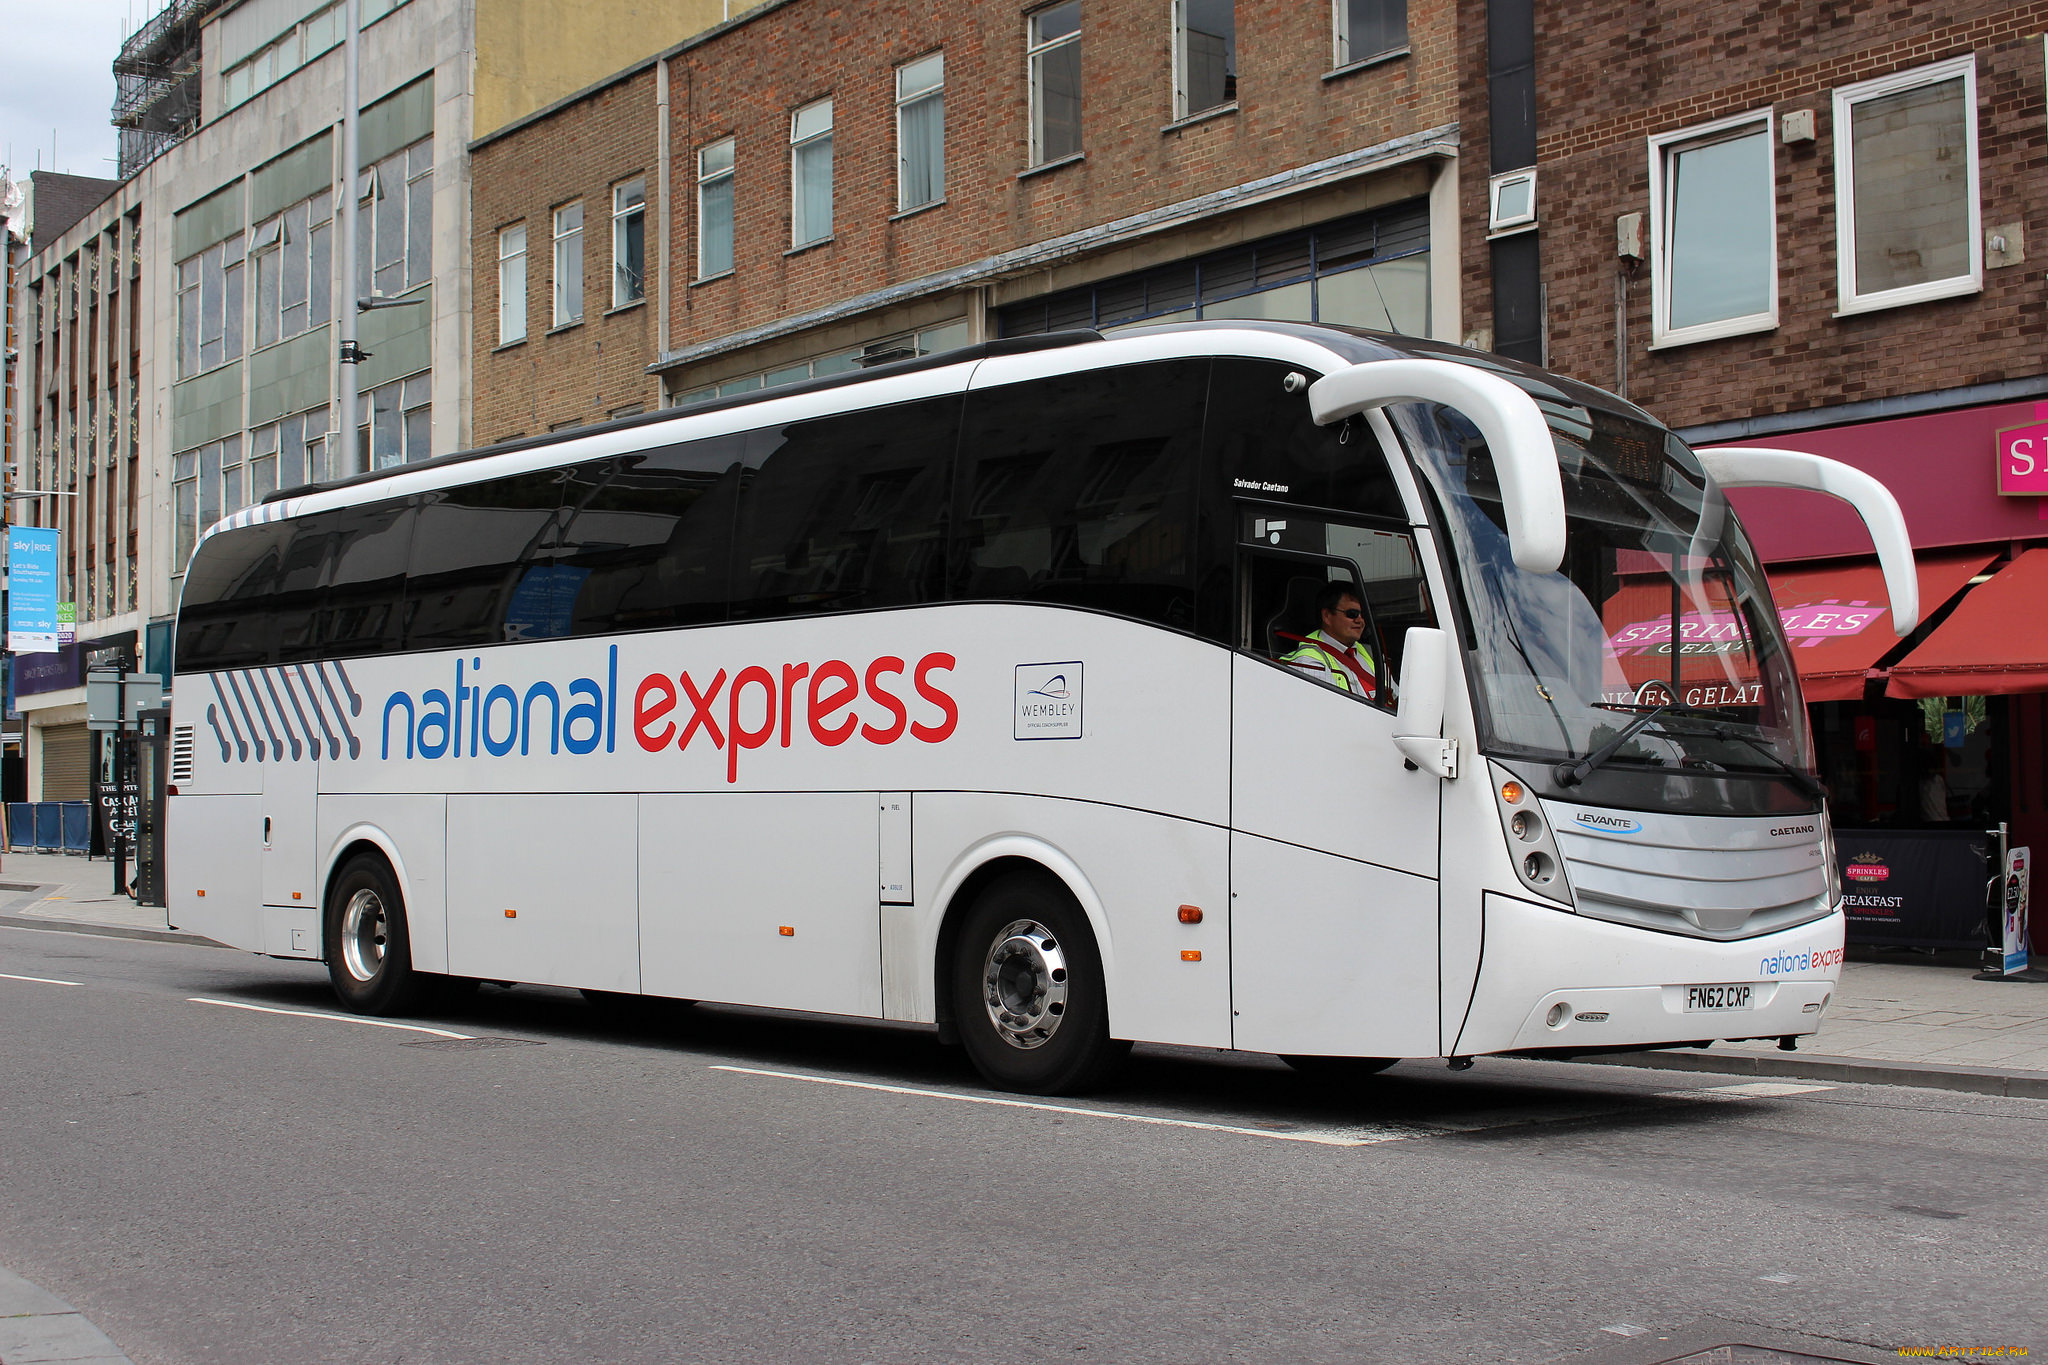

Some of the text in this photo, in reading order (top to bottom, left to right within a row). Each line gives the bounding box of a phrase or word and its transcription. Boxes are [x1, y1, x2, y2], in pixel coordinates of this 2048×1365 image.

[1234, 478, 1289, 492] Salvador Caetano
[13, 540, 52, 552] sky RIDE
[37, 619, 52, 630] sky
[1616, 612, 1869, 643] SPRINLES
[381, 644, 959, 784] national express
[1022, 703, 1075, 717] WEMBLEY
[1576, 812, 1815, 837] LEVANTE CAETANO
[1847, 868, 1888, 876] SPRINKLES
[1840, 894, 1903, 908] REAKFAST
[1760, 946, 1810, 976] national
[1689, 986, 1750, 1009] FN62 CXP
